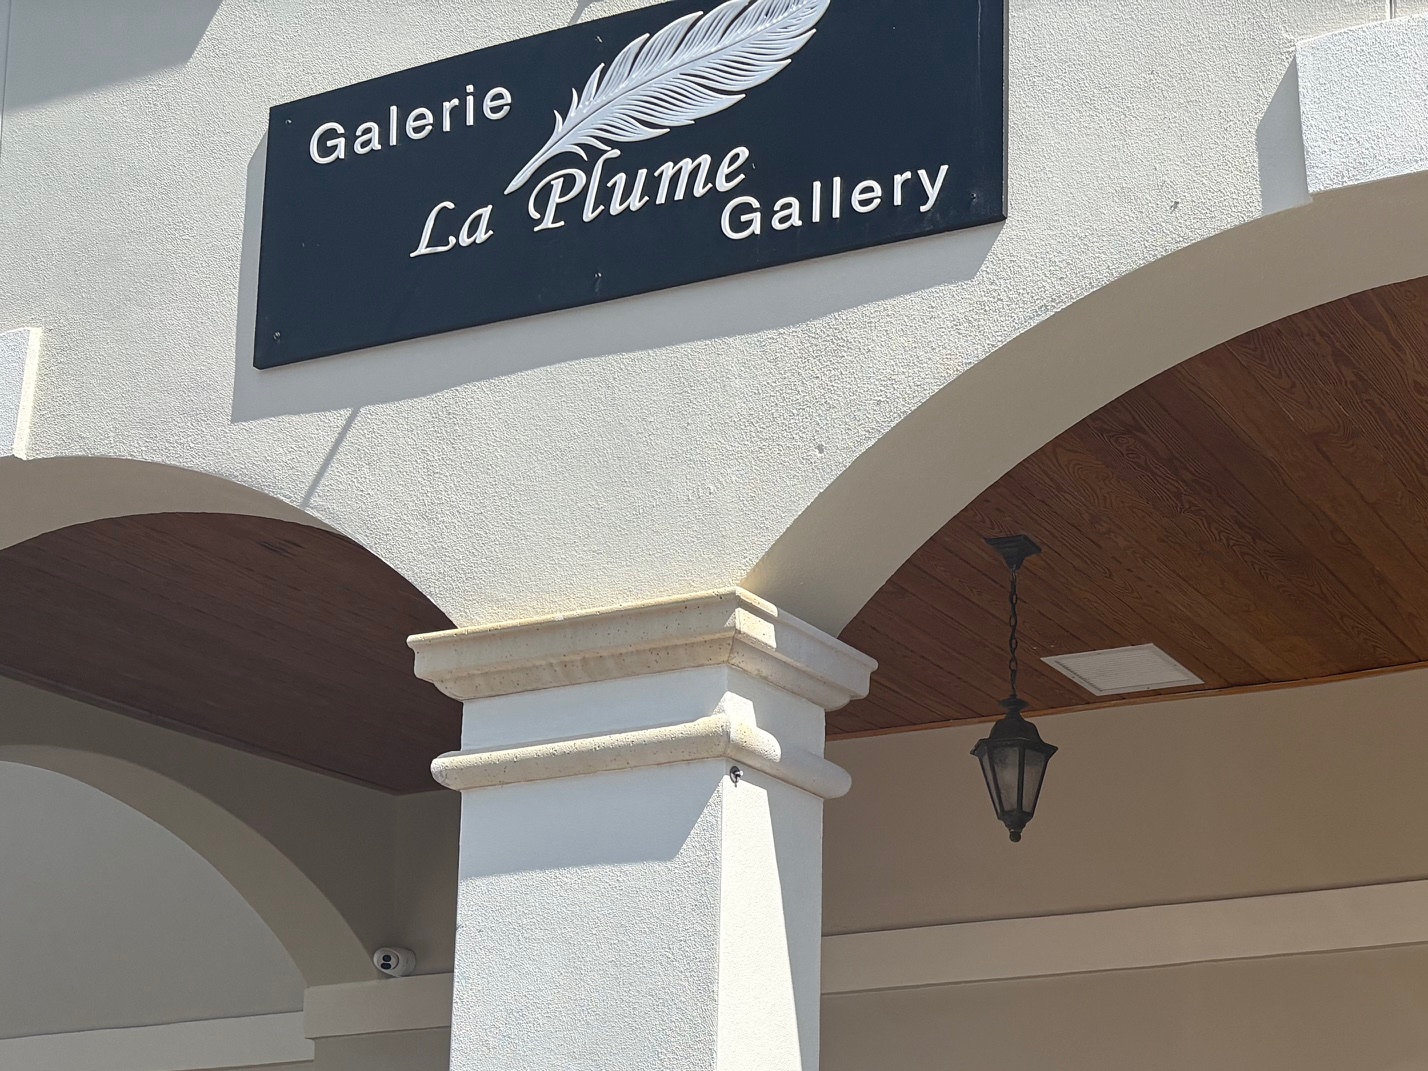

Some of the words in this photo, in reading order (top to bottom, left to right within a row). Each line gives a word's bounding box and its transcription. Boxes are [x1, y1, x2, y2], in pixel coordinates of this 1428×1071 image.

[309, 85, 513, 165] Galerie
[410, 201, 494, 258] La
[529, 146, 749, 233] Plume
[721, 164, 950, 240] Gallery
